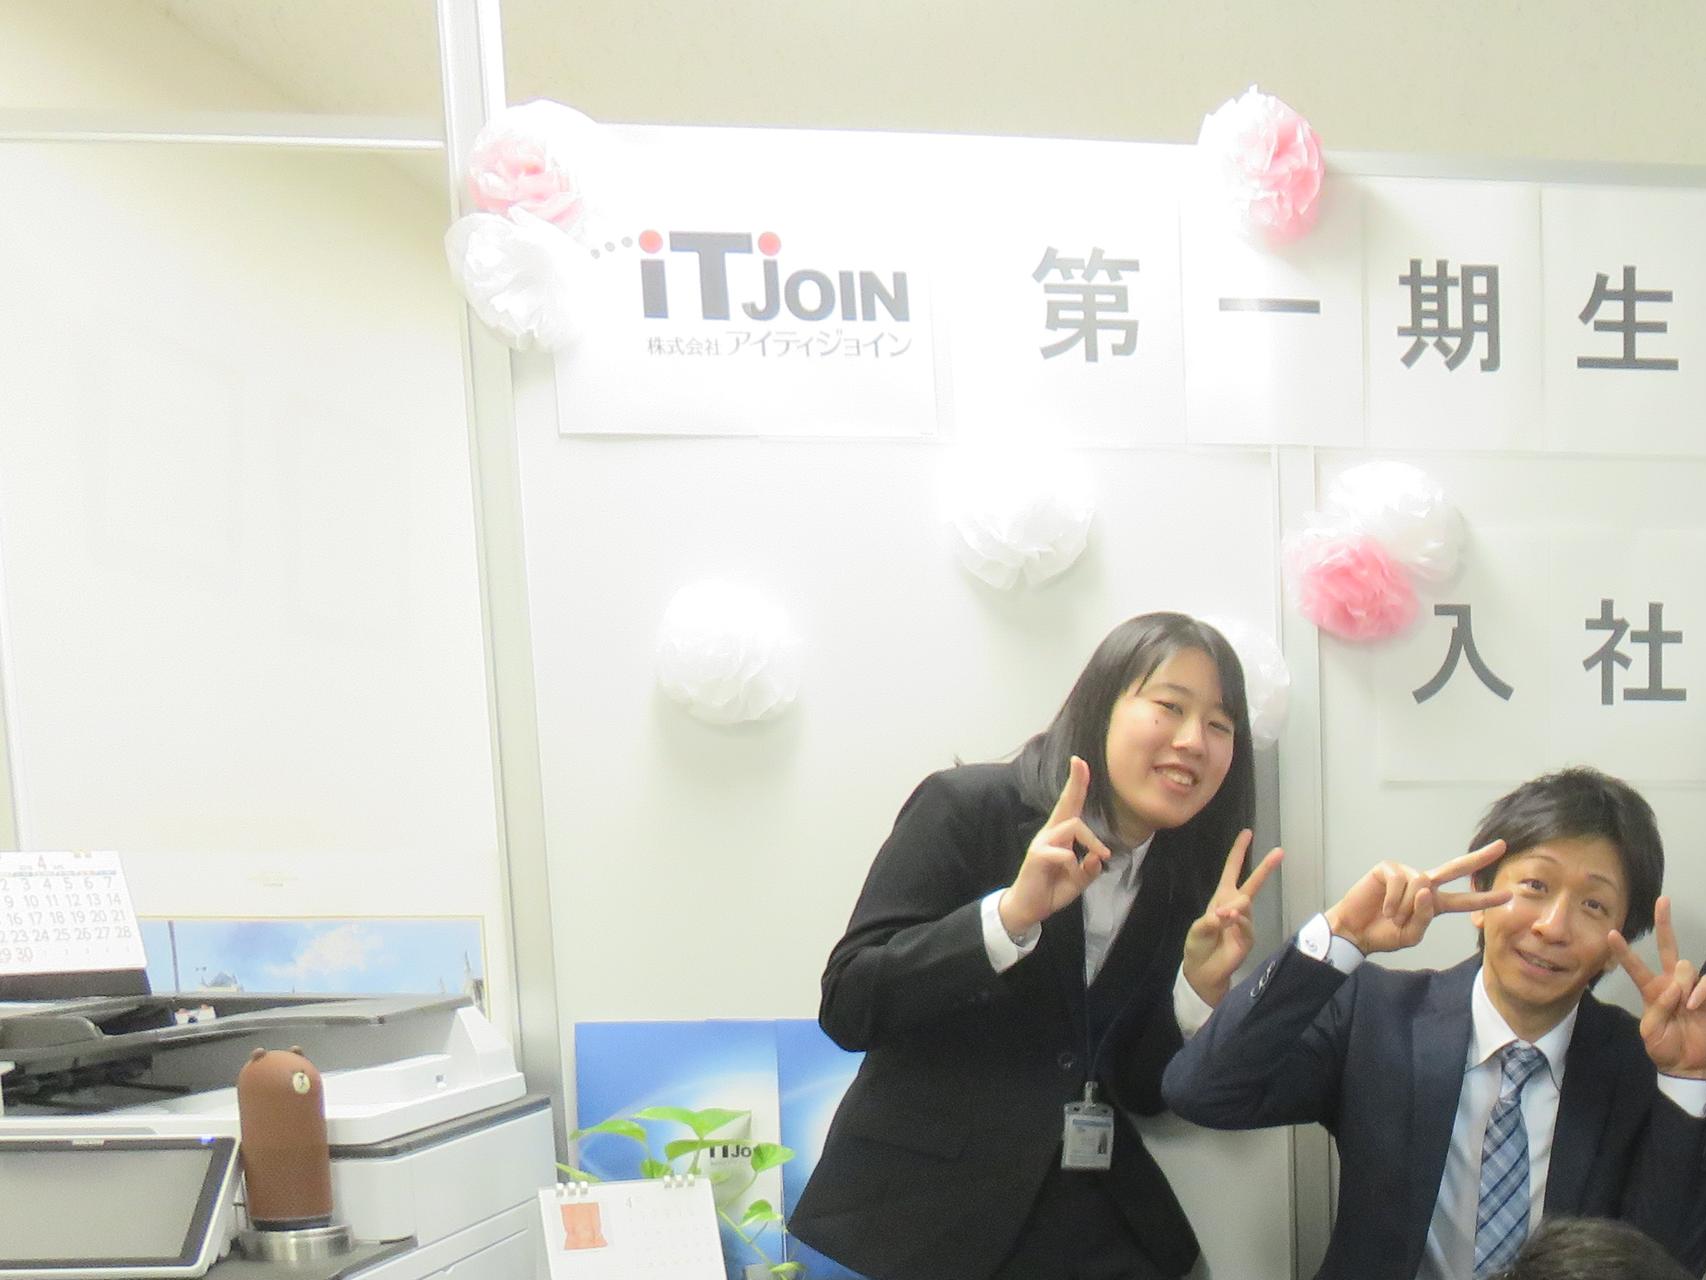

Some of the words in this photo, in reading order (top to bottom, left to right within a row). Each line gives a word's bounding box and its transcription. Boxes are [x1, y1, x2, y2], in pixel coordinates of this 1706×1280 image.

[648, 336, 719, 356] 株式会社
[724, 328, 912, 358] アイティジョイン
[1, 879, 10, 891] 2
[23, 879, 31, 891] 3
[43, 878, 52, 890] 4
[63, 877, 73, 889] 5
[84, 877, 94, 889] 6
[103, 876, 112, 888] 7
[4, 895, 14, 908] 9
[24, 894, 39, 907] 10
[45, 894, 59, 906] 11
[65, 894, 81, 906] 12
[86, 893, 101, 906] 13
[106, 893, 121, 905] 14
[7, 913, 23, 926] 16
[28, 912, 42, 925] 17
[49, 911, 65, 924] 18
[70, 911, 85, 923] 19
[90, 910, 107, 922] 20
[111, 910, 126, 922] 21
[10, 929, 29, 943] 23
[32, 929, 49, 942] 24
[53, 928, 71, 941] 25
[74, 928, 92, 940] 26
[94, 927, 110, 940] 27
[114, 926, 132, 938] 28
[15, 947, 33, 962] 30
